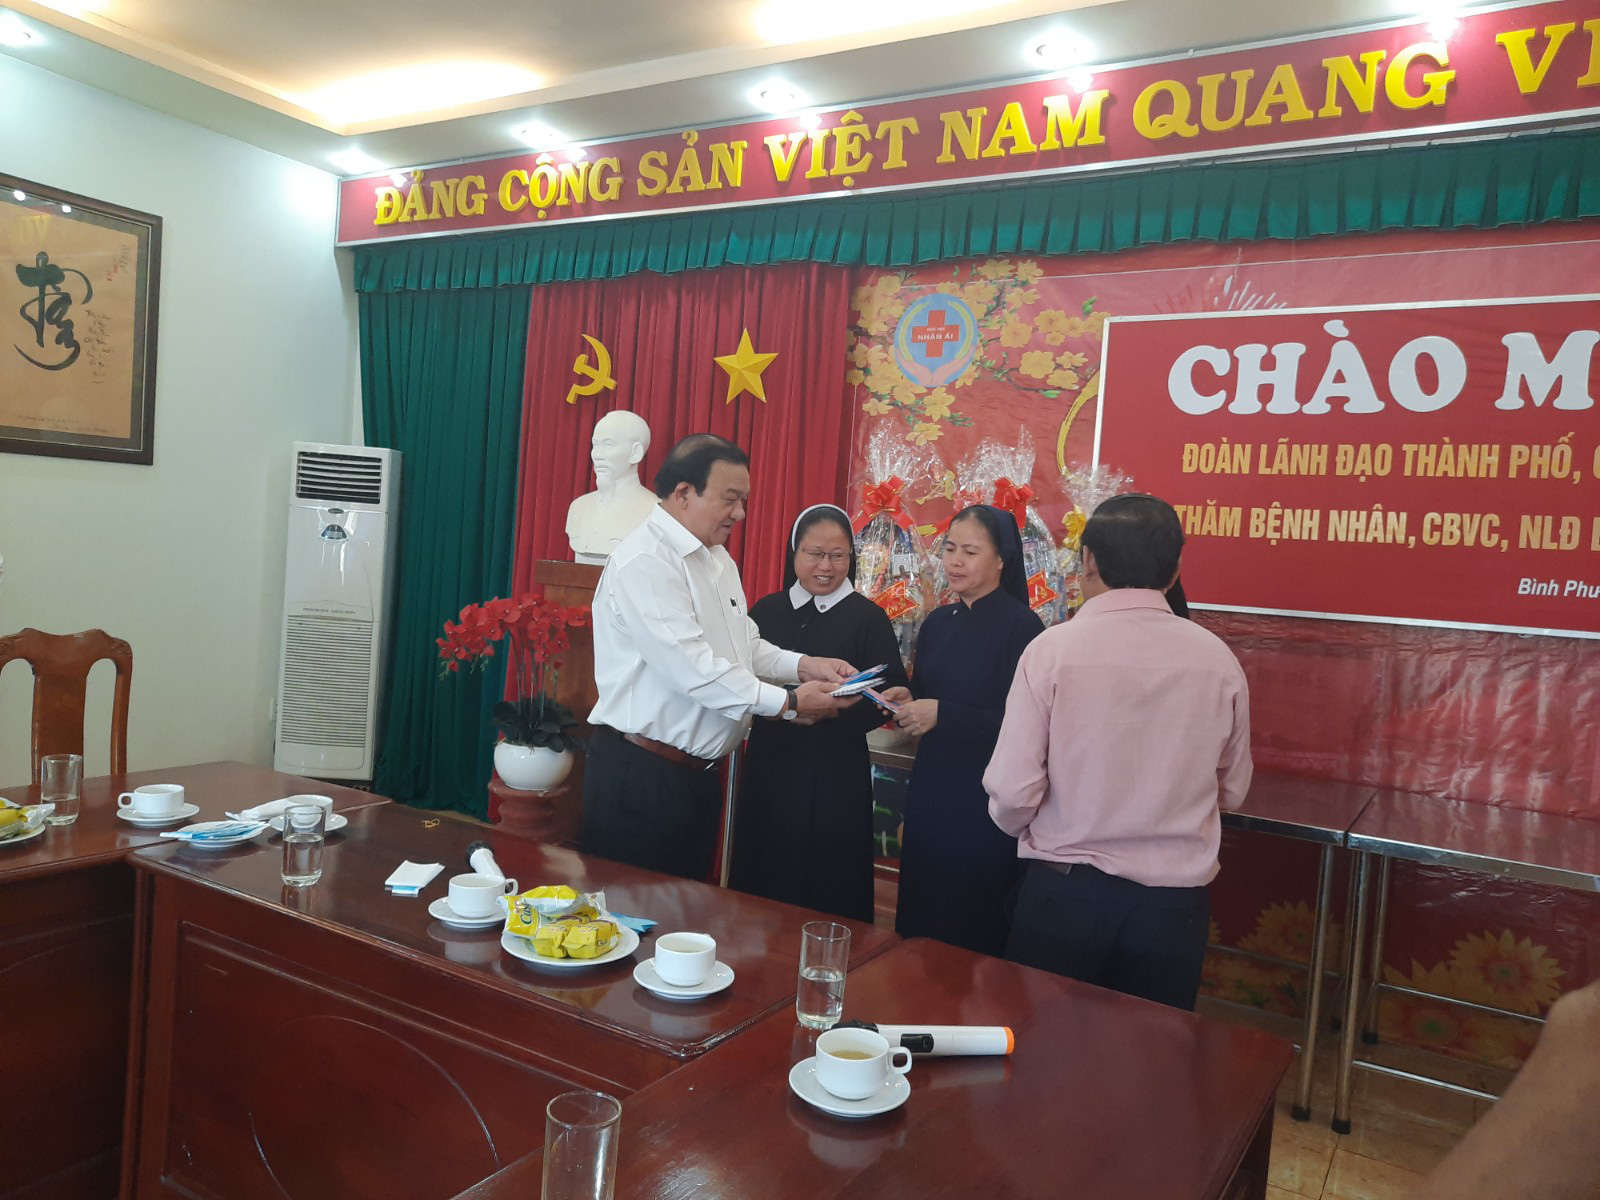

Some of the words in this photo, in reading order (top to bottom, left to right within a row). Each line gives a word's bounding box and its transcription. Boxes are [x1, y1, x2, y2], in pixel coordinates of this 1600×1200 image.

[374, 169, 486, 226] ĐẢNG
[498, 152, 623, 220] CỘNG
[636, 128, 749, 198] SẢN
[763, 108, 921, 188] VIỆT
[936, 88, 1111, 164] NAM
[1132, 42, 1456, 140] QUANG
[1168, 319, 1467, 416] CHÀO
[1181, 437, 1251, 475] ĐOÀN
[1259, 438, 1328, 476] LÃNH
[1335, 444, 1393, 483] ĐẠO
[1402, 438, 1500, 478] THÀNH
[1508, 431, 1581, 485] PHỐ,
[1249, 502, 1321, 547] BỆNH
[1328, 504, 1416, 549] NHÂN,
[1422, 512, 1509, 553] CBVC,
[1518, 514, 1581, 551] NLĐ
[1518, 577, 1559, 597] Bình
